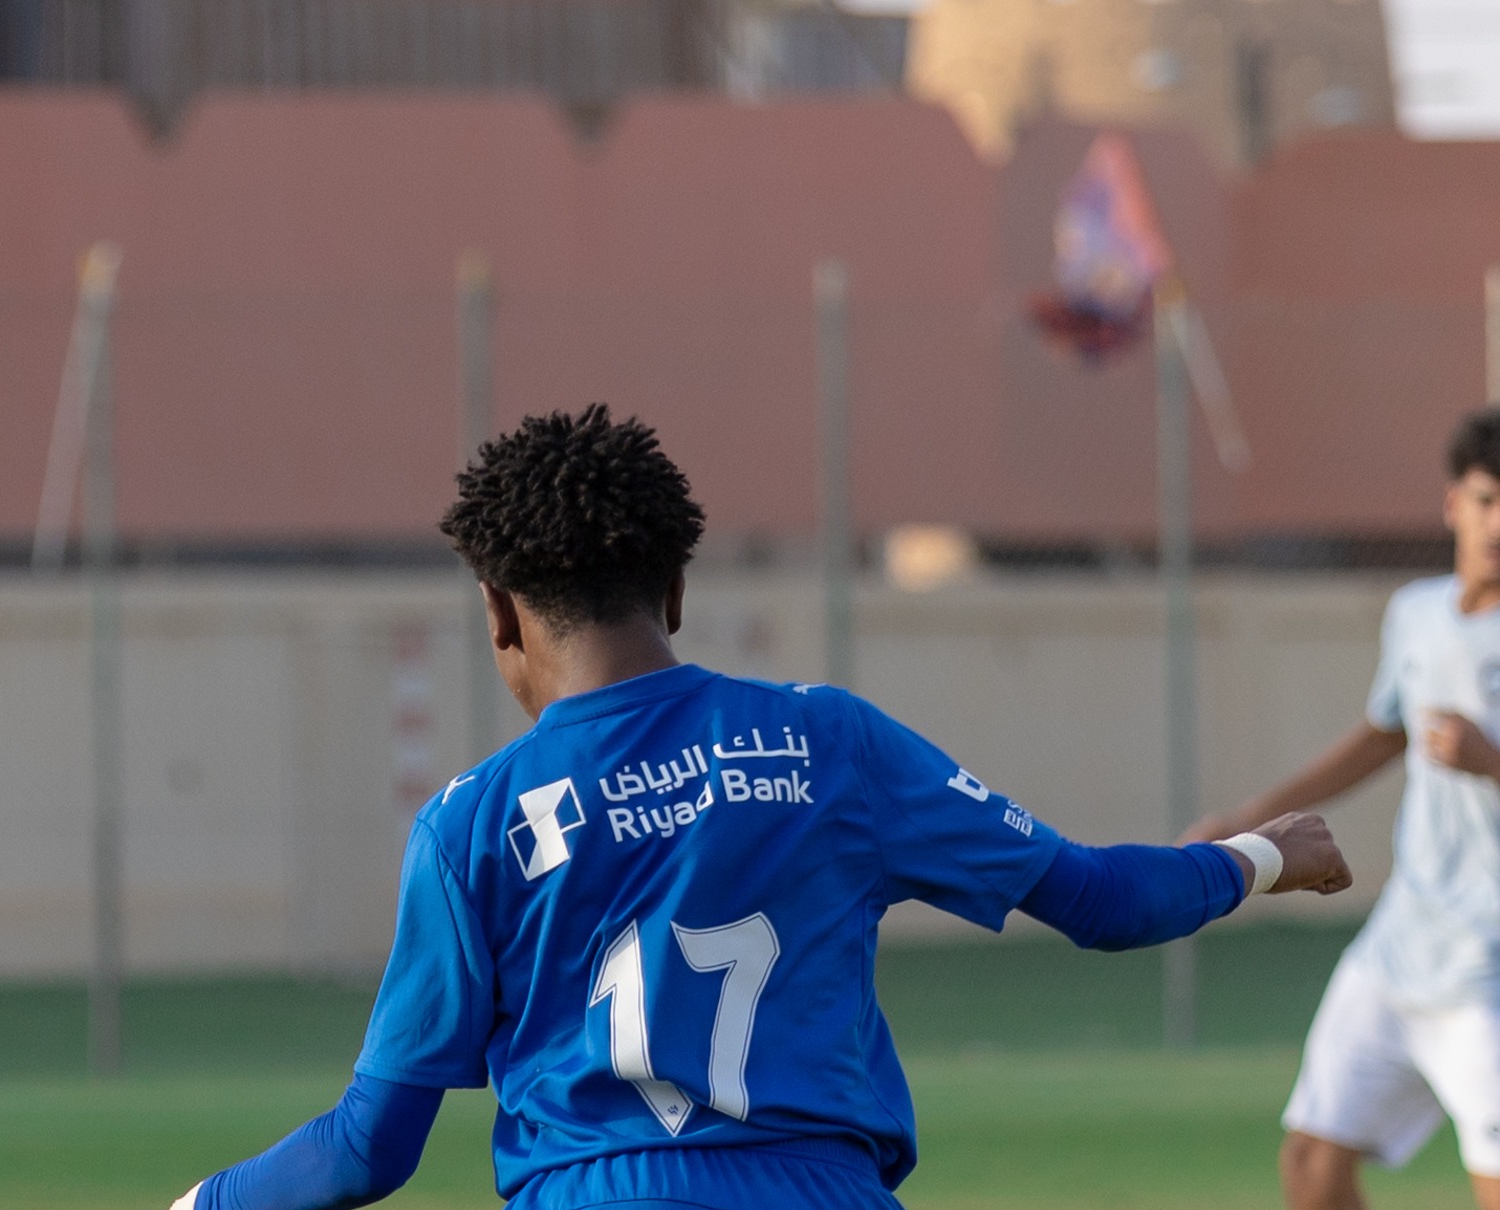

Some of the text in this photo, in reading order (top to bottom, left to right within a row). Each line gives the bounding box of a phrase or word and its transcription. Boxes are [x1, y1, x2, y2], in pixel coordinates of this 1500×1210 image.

[598, 726, 810, 802] بنك الرياض
[606, 768, 815, 843] Riyad Bank
[588, 911, 781, 1138] 17
